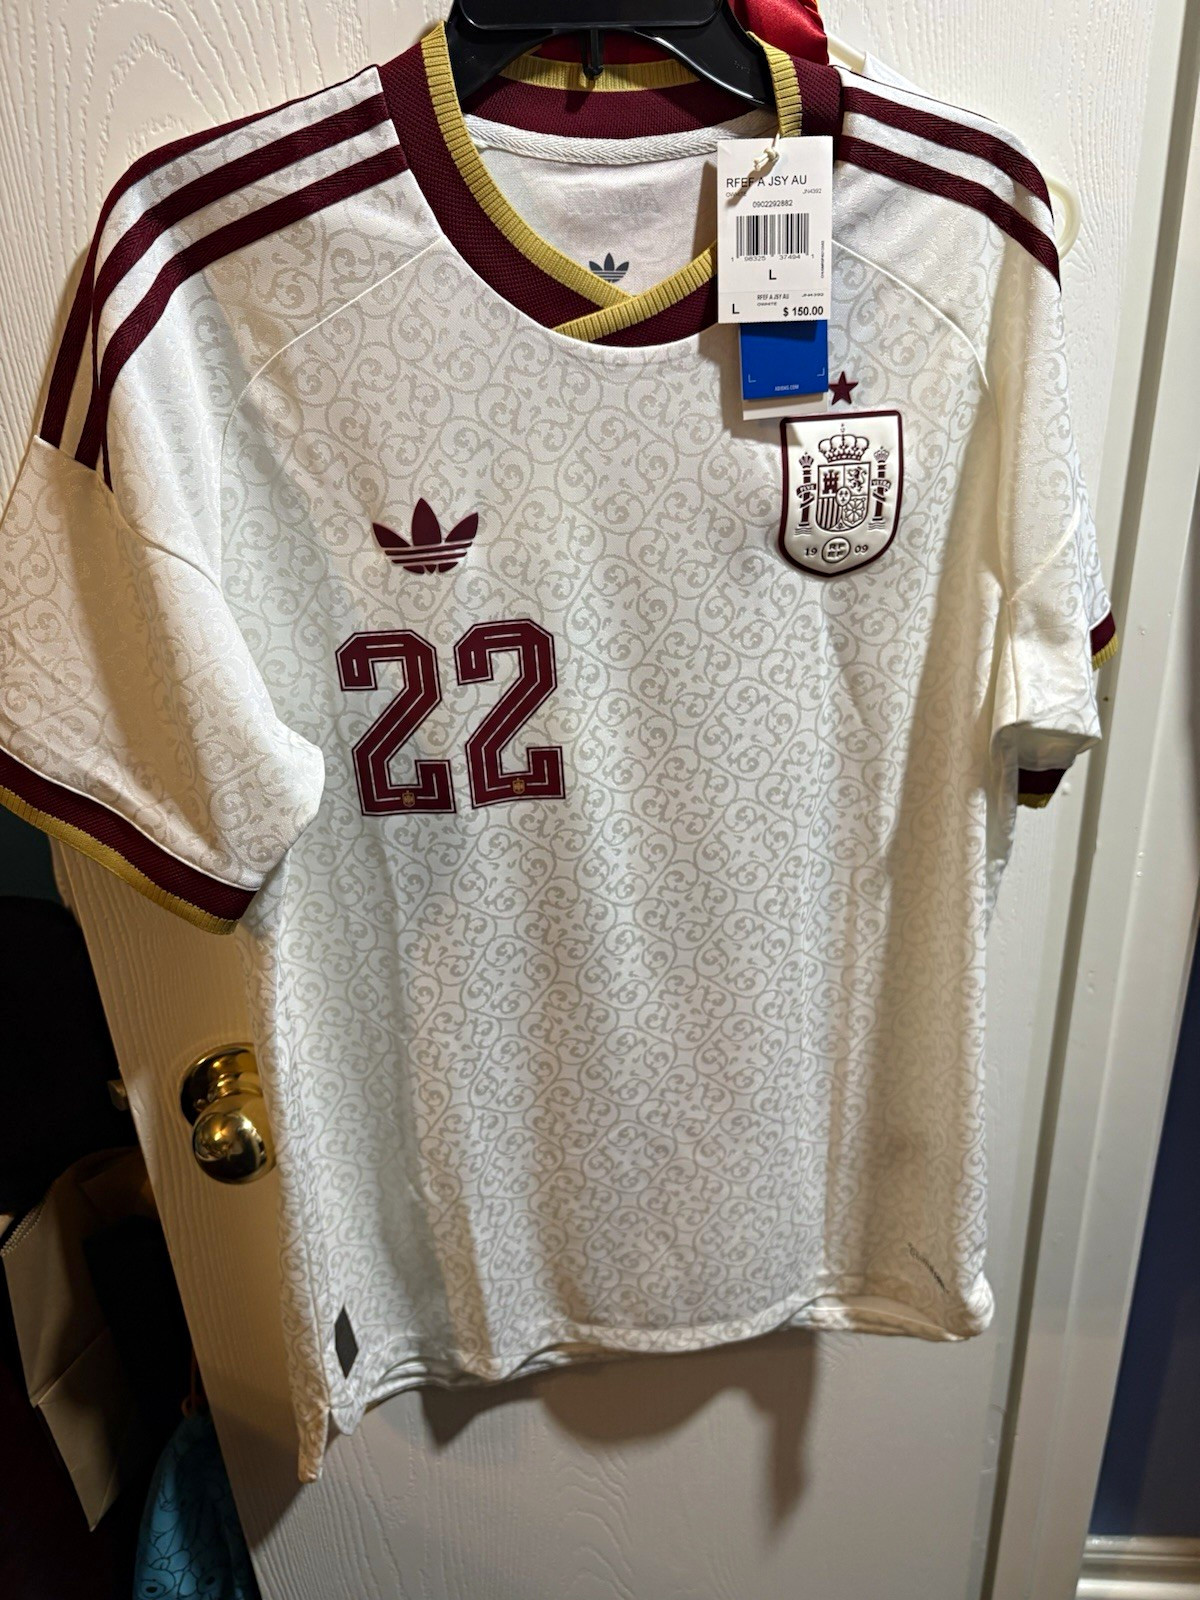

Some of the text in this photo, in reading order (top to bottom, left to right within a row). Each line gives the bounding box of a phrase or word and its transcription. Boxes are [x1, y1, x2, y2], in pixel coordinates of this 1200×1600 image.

[726, 174, 807, 188] RFEF A JSY AU
[752, 200, 793, 208] 0902292882
[769, 269, 777, 281] L
[732, 303, 740, 315] L
[783, 306, 824, 318] $ 150.00
[805, 547, 818, 556] 19
[854, 544, 869, 554] 09
[335, 618, 566, 817] 22
